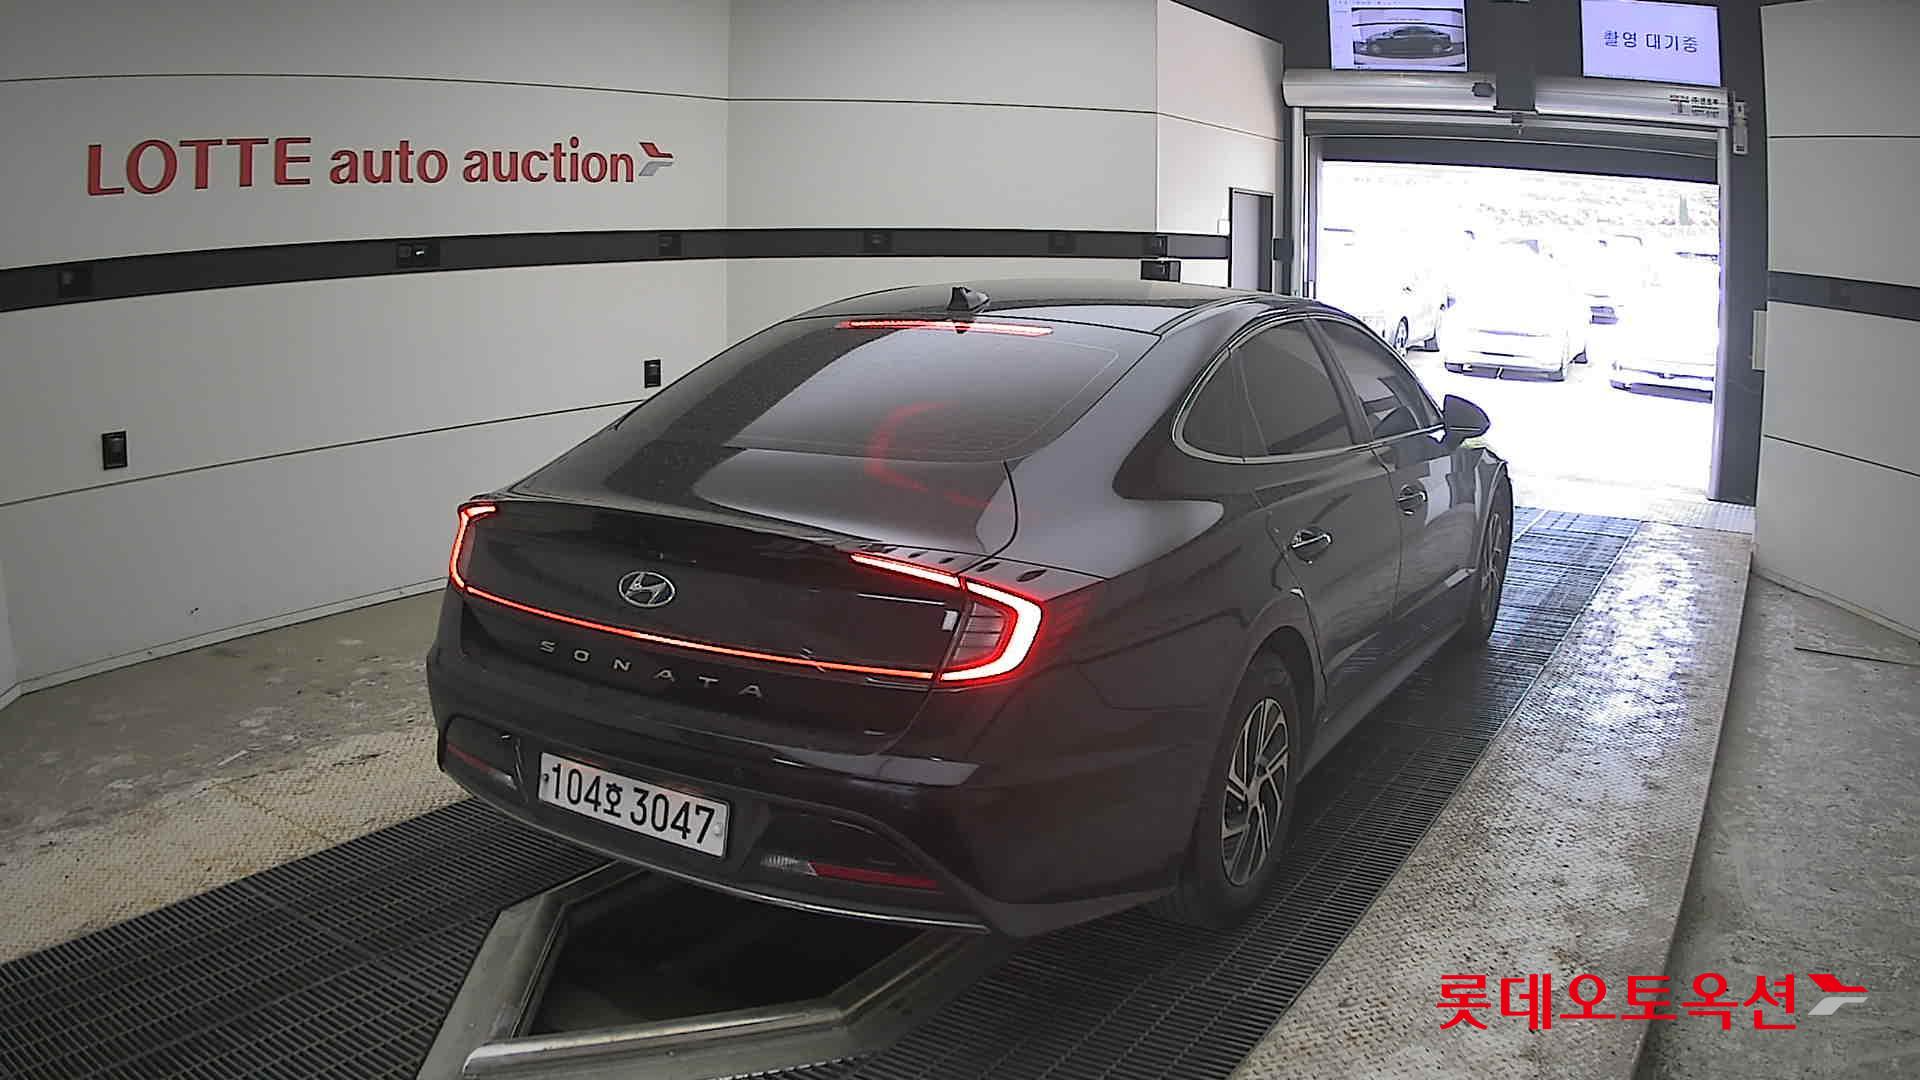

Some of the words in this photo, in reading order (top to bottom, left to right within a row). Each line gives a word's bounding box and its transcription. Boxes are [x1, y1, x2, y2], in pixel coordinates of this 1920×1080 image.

[1645, 33, 1697, 53] 대기중
[87, 137, 312, 196] LOTTE
[329, 140, 449, 185] auto
[462, 136, 635, 183] auction
[540, 640, 763, 698] SONATA
[630, 786, 715, 844] 3047
